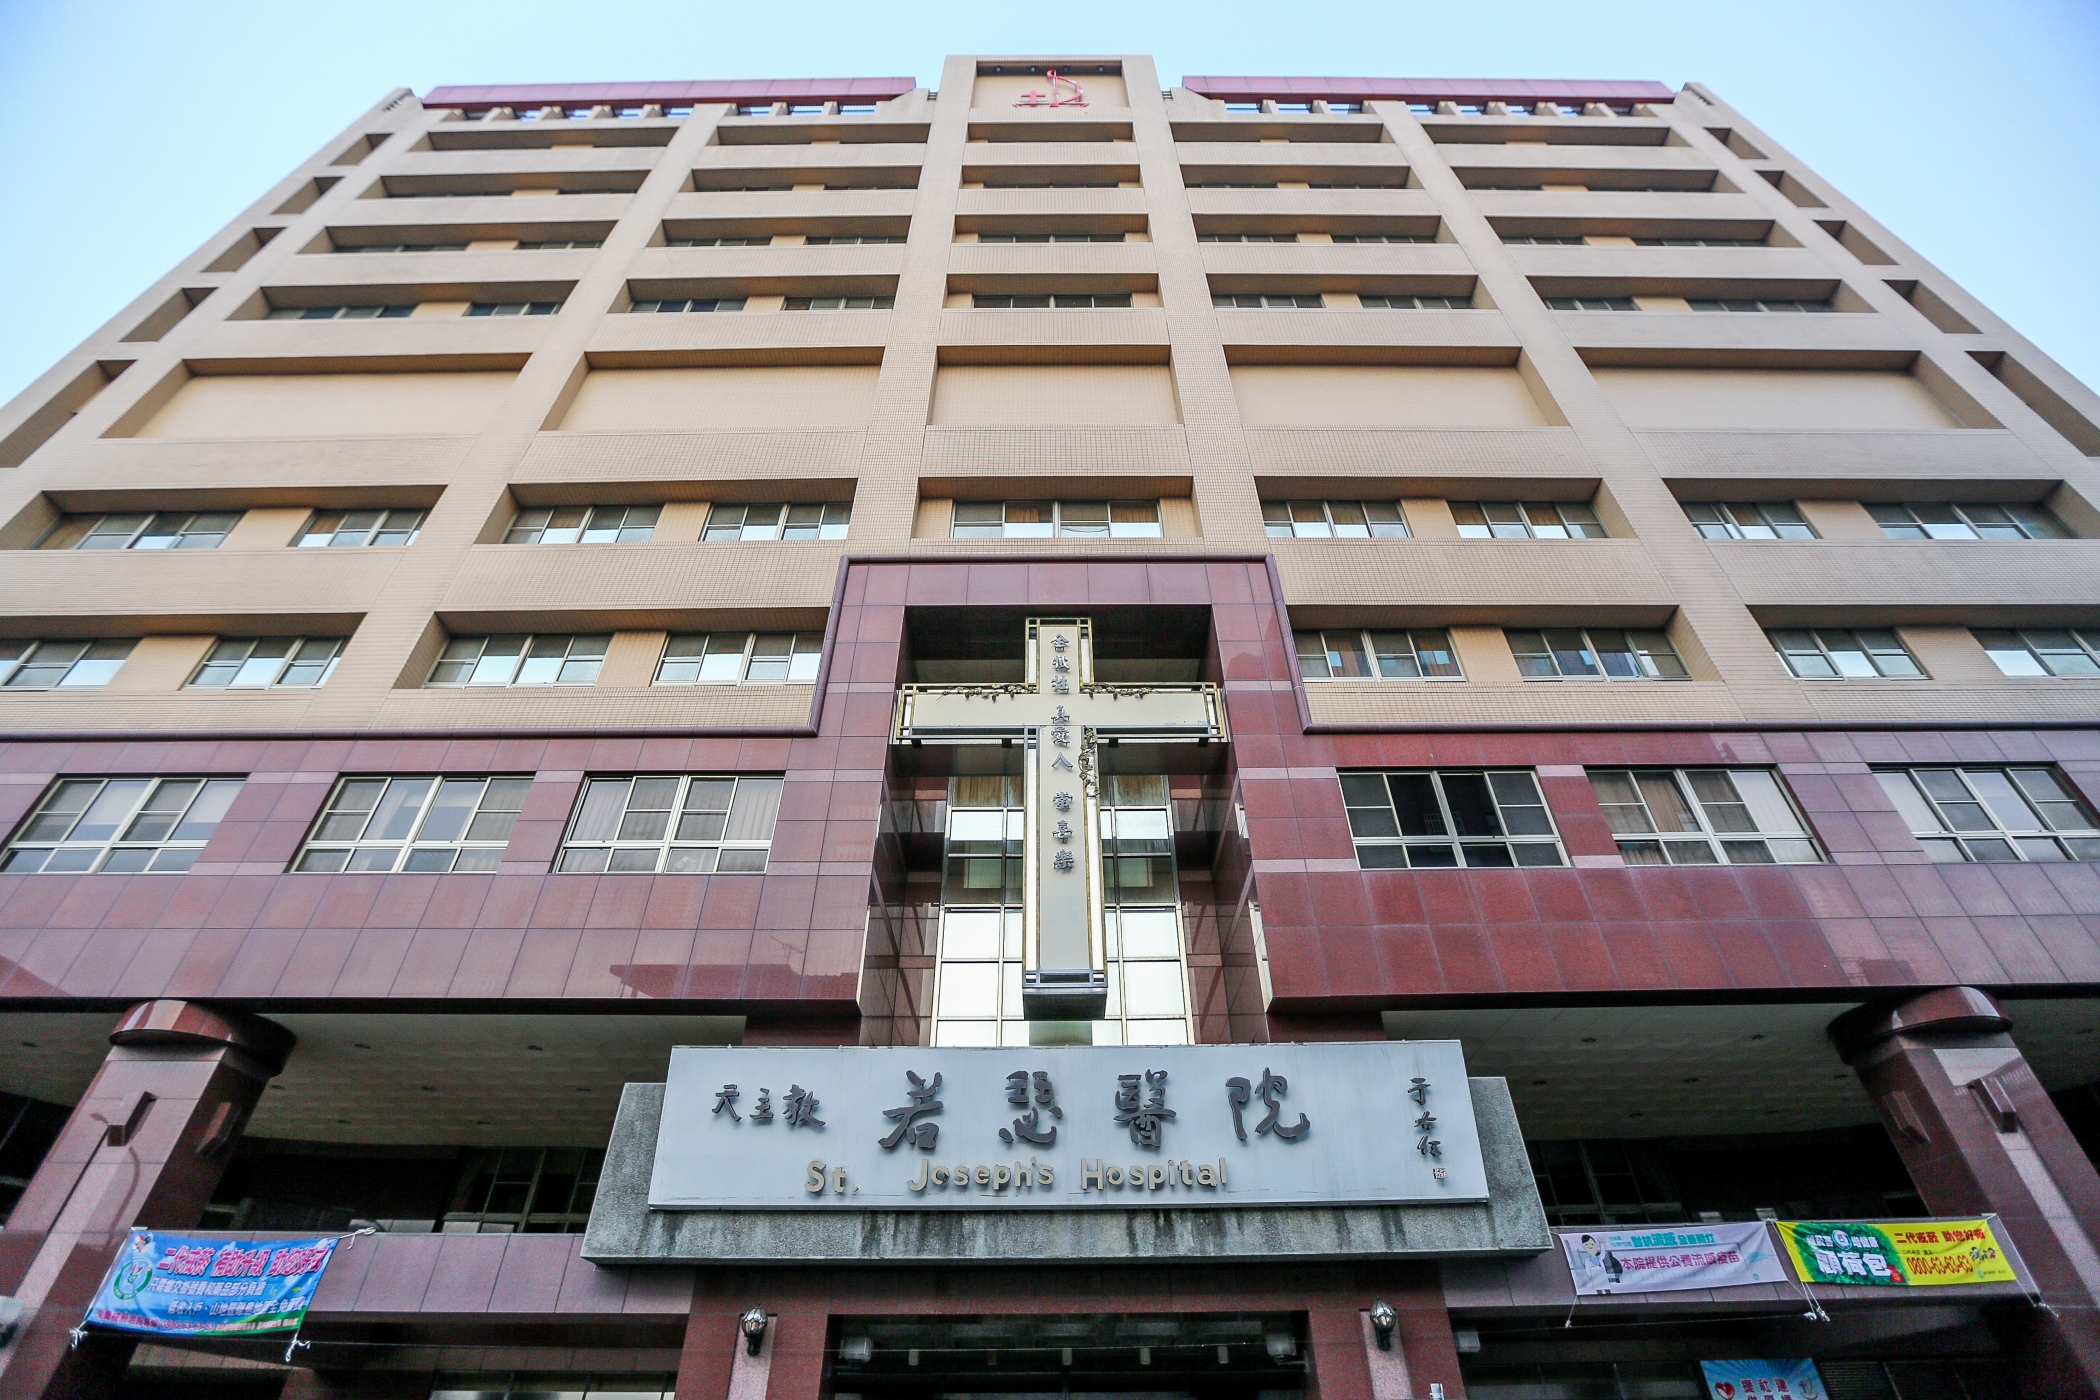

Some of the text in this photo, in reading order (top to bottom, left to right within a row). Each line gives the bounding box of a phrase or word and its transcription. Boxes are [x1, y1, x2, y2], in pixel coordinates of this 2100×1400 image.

[1051, 705, 1074, 771] 真愛人
[1052, 790, 1075, 871] 常喜樂
[711, 1067, 1312, 1149] 天主教 若瑟醫院
[804, 1156, 1229, 1195] St. Joseph's Hospital
[1631, 1231, 1716, 1248] 對抗流感 全面開打
[157, 1245, 214, 1277] 二代戒菸
[1620, 1250, 1742, 1271] 本院提供公費流感疫苗
[1815, 1251, 1891, 1277] 顧荷包
[1906, 1254, 1974, 1275] 0800-63-63-63
